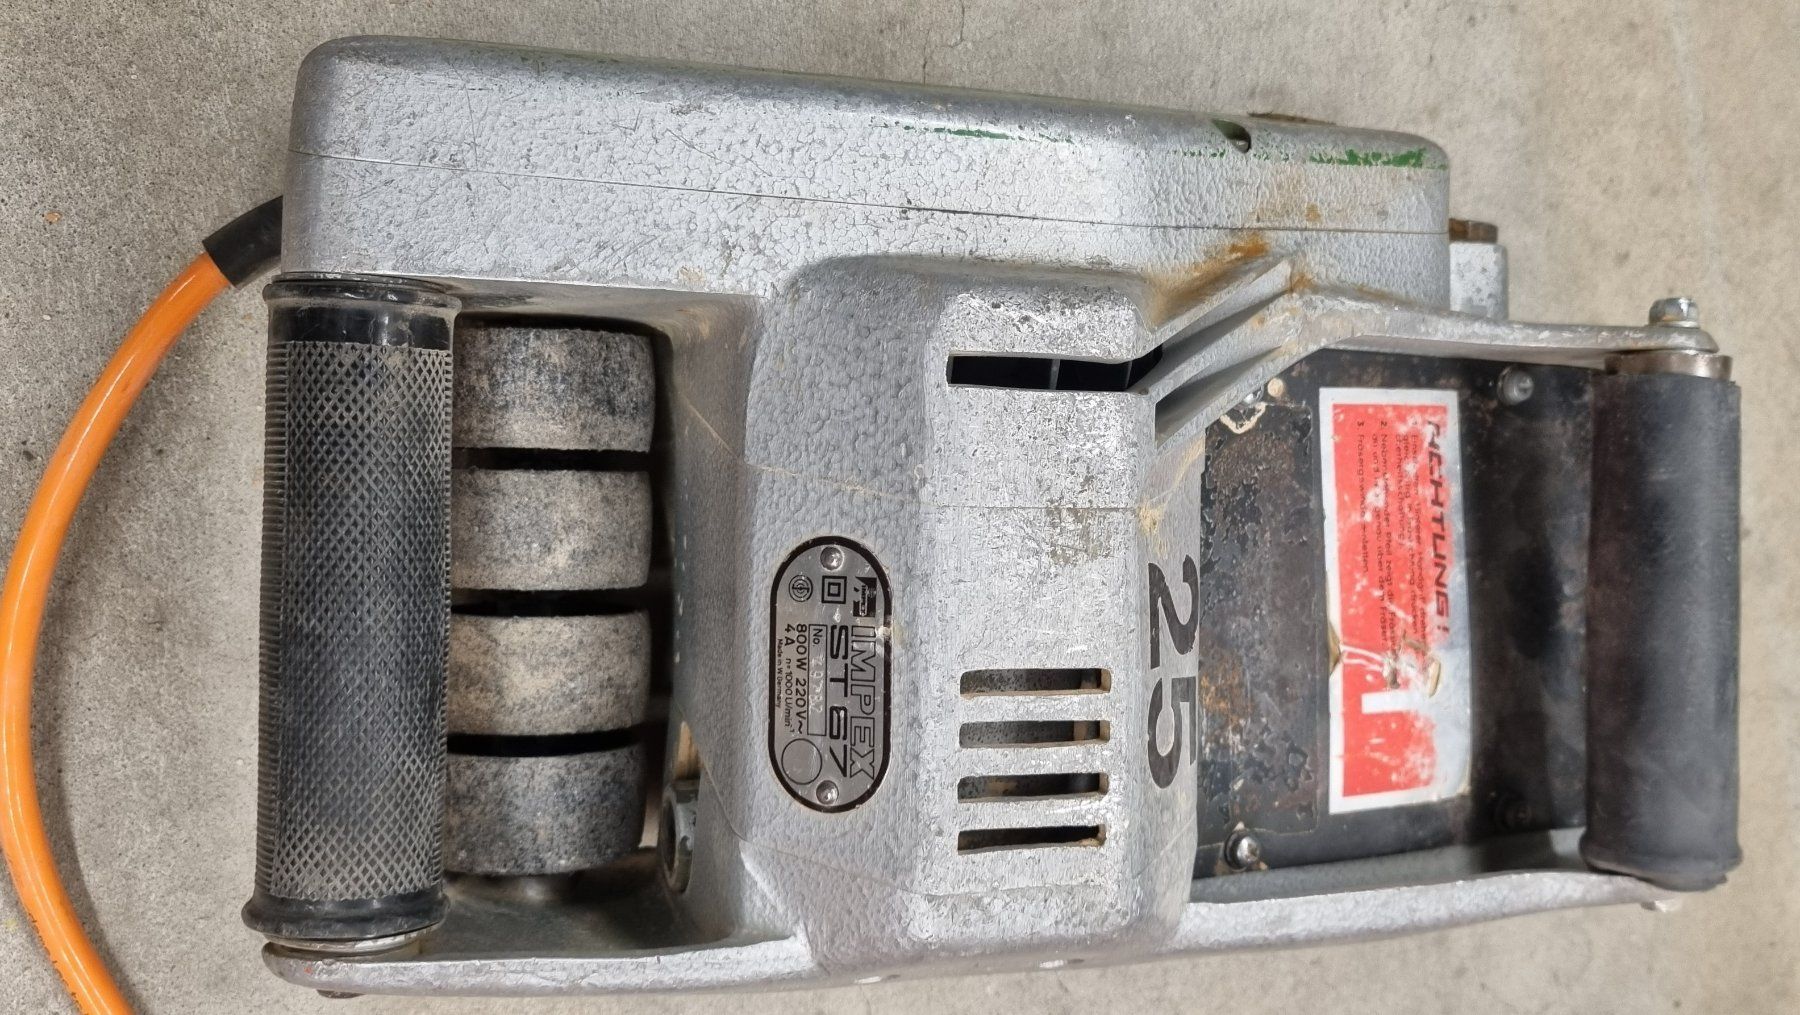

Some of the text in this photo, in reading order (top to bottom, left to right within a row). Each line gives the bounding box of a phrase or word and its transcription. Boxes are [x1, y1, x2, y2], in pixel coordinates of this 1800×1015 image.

[829, 625, 849, 777] ST 67
[850, 625, 876, 780] IMPEX
[1148, 554, 1200, 789] 25
